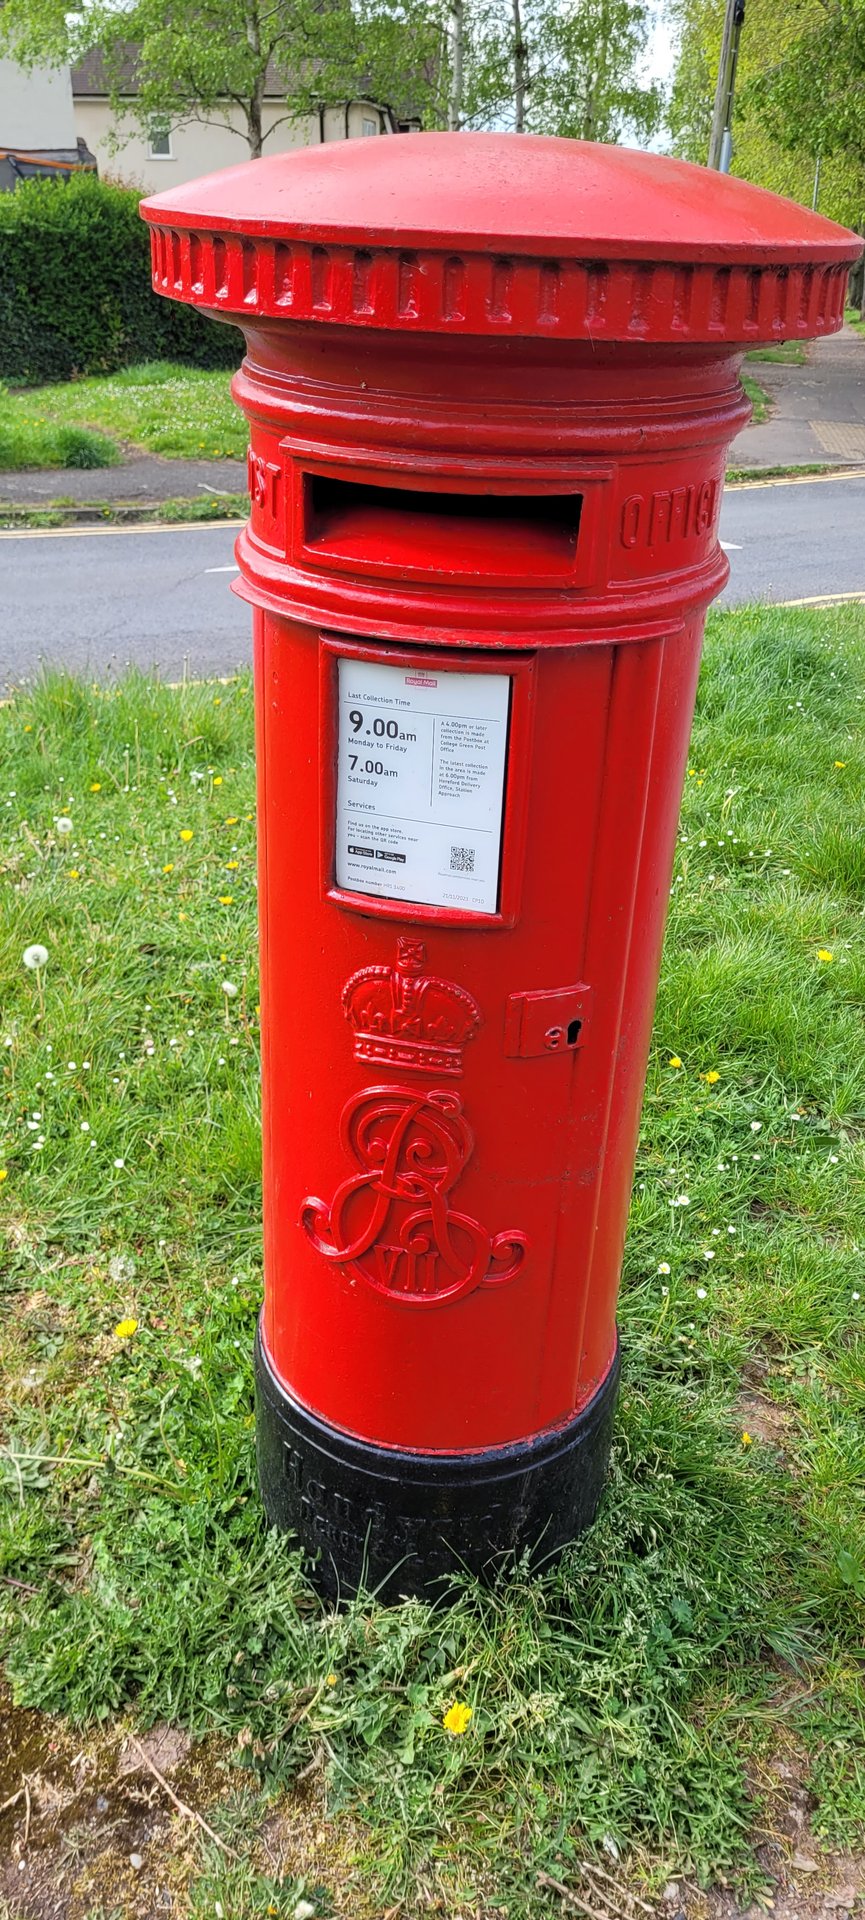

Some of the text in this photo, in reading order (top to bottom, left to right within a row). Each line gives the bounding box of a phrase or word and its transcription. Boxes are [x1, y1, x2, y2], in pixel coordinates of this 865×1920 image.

[406, 677, 436, 688] Royal Mail
[348, 691, 411, 707] Last Collection Time
[349, 710, 417, 742] 9.00am
[446, 721, 468, 729] 4.00pm
[348, 737, 375, 748] Monday
[385, 742, 408, 753] Friday
[348, 754, 398, 777] 7.00am
[348, 775, 378, 787] Saturday
[461, 781, 481, 789] Delivery
[348, 800, 376, 810] Services
[356, 827, 373, 835] locating
[347, 861, 397, 874] www.royalmail.com
[366, 878, 382, 886] number
